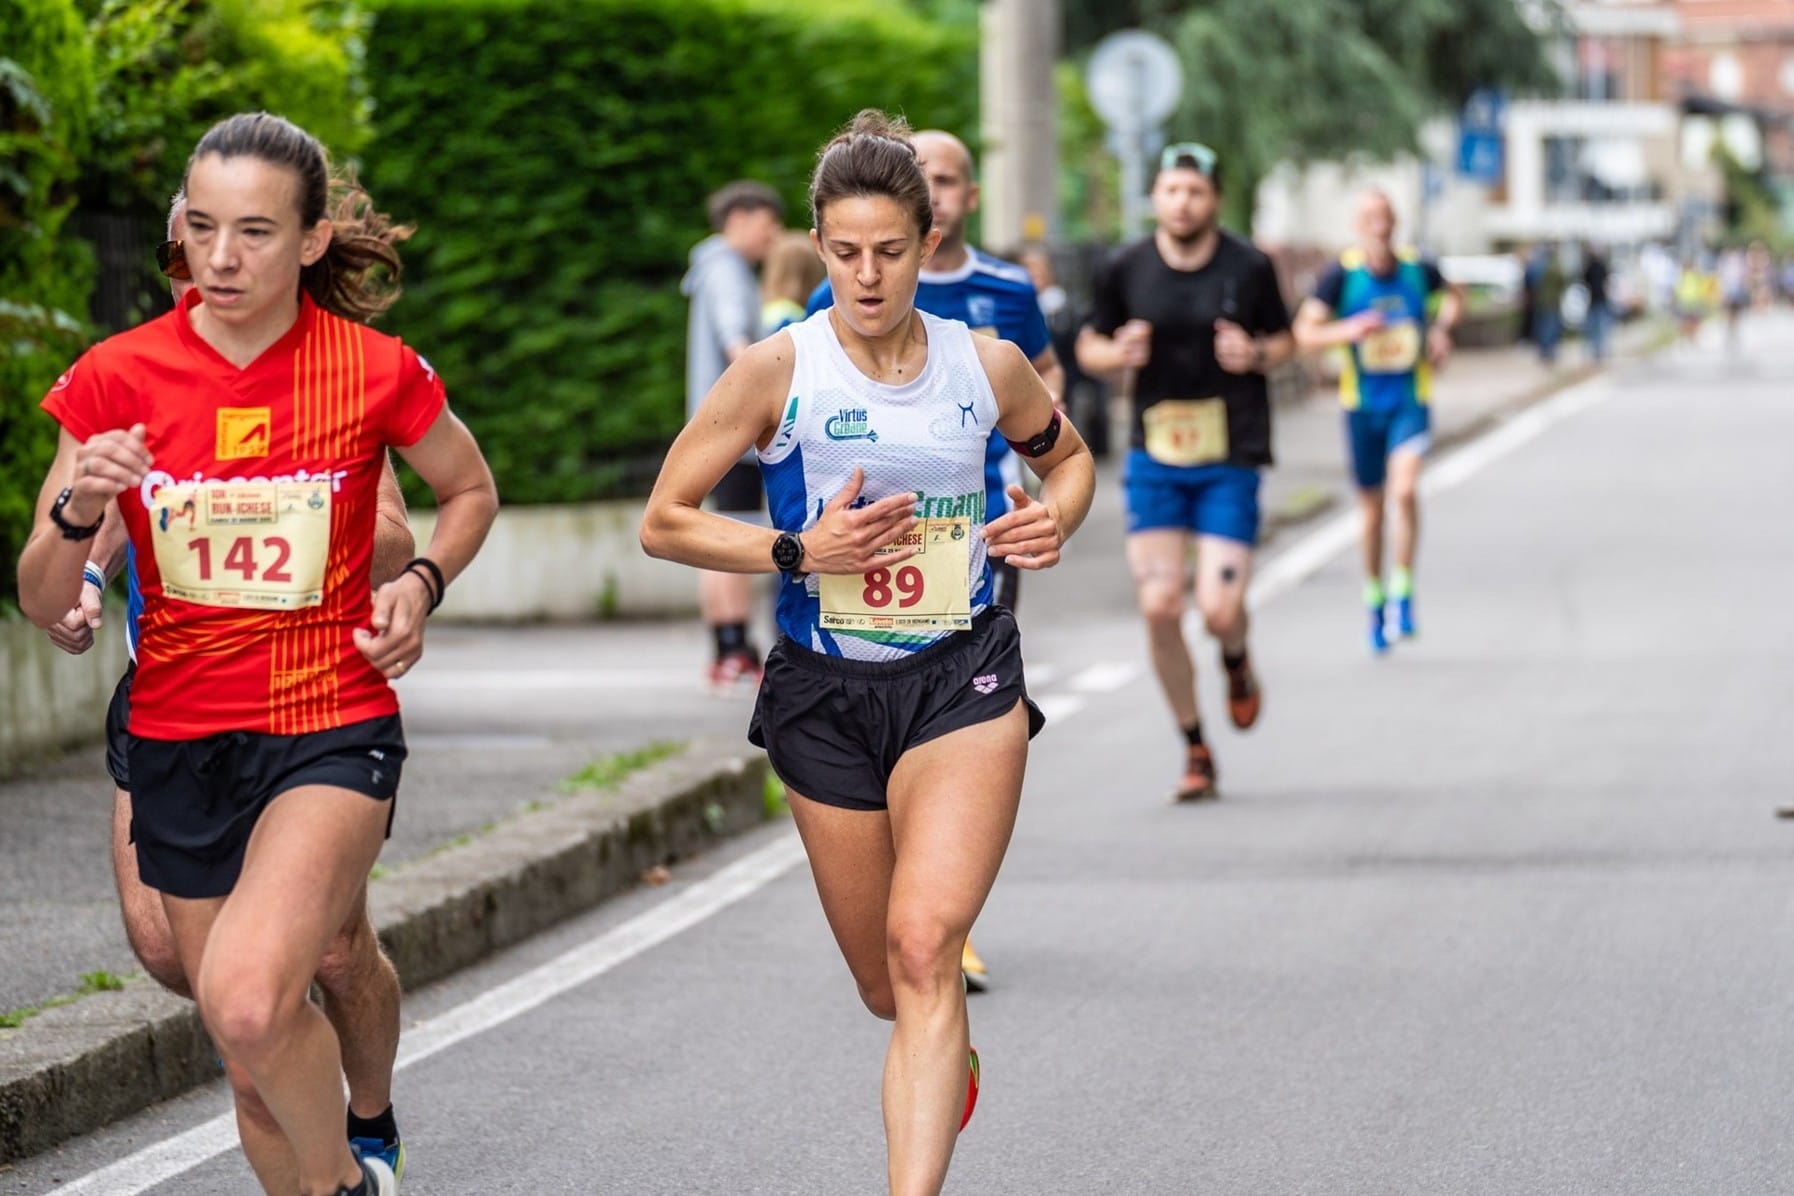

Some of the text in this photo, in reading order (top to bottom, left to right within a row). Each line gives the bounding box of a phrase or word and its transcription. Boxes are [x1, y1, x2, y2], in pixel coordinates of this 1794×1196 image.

[839, 408, 868, 422] Virtus
[187, 535, 292, 583] 142
[862, 565, 925, 609] 89
